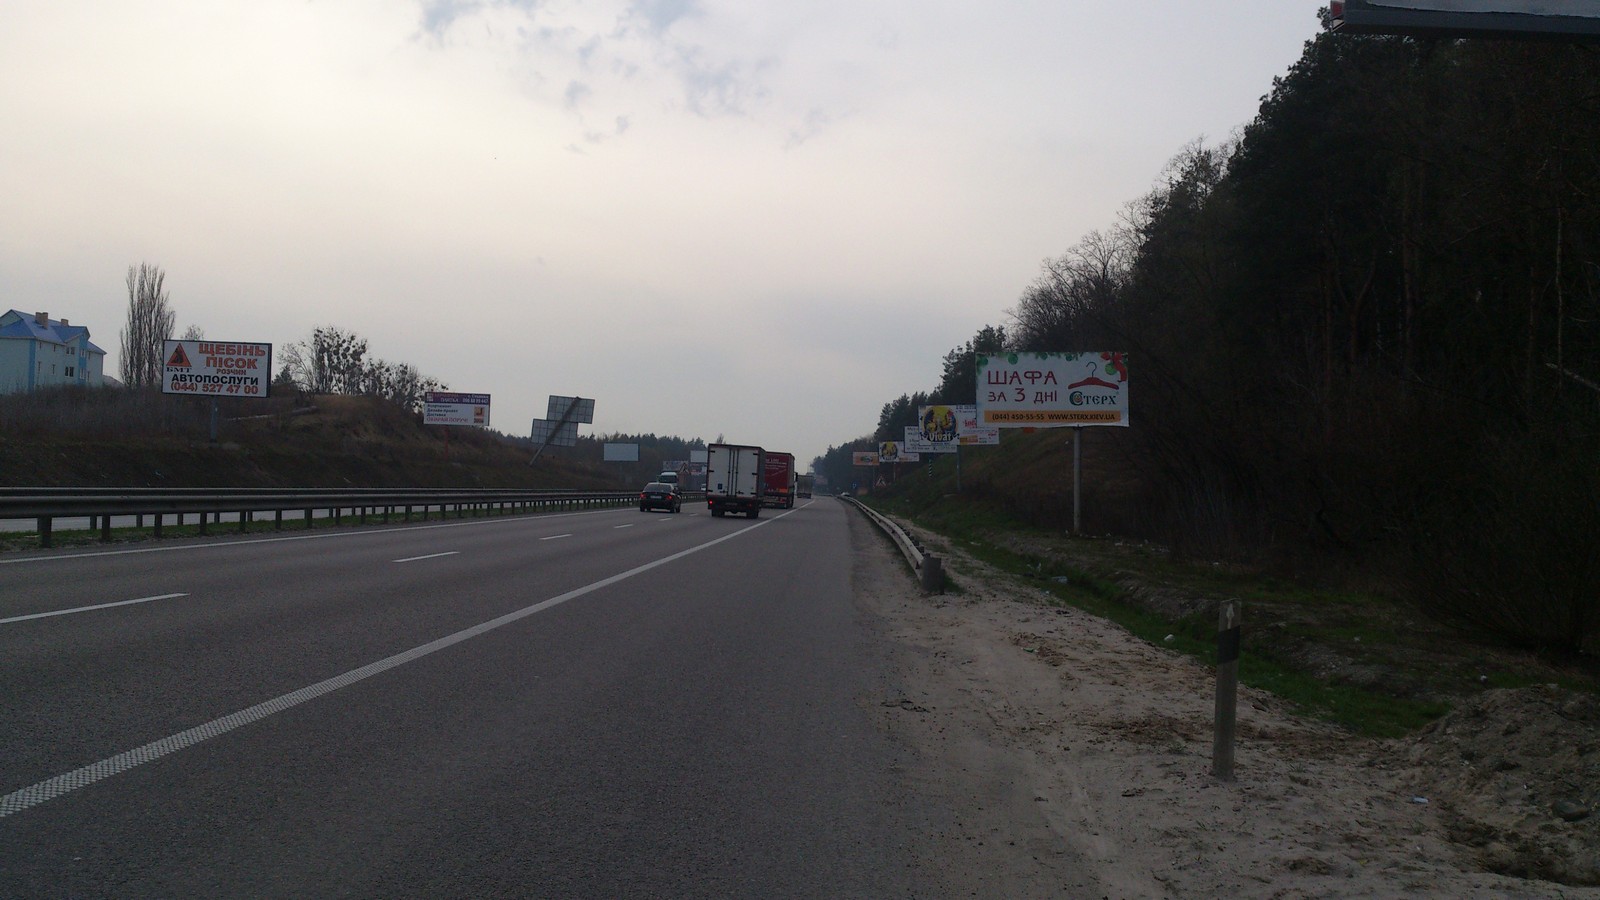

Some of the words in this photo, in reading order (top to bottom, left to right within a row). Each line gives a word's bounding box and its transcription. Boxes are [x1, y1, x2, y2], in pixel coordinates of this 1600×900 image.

[198, 343, 266, 356] ЩЕБІНЬ
[205, 356, 258, 369] ПІСОК
[216, 368, 247, 376] РОЗЧИН
[987, 370, 1058, 385] ШАФА
[171, 374, 259, 386] АВТОПОСЛУГИ
[170, 382, 198, 392] (044)
[202, 384, 223, 393] 527
[226, 384, 241, 394] 47
[244, 385, 259, 394] 00
[987, 391, 1007, 402] ЗА
[1014, 387, 1026, 402] 3
